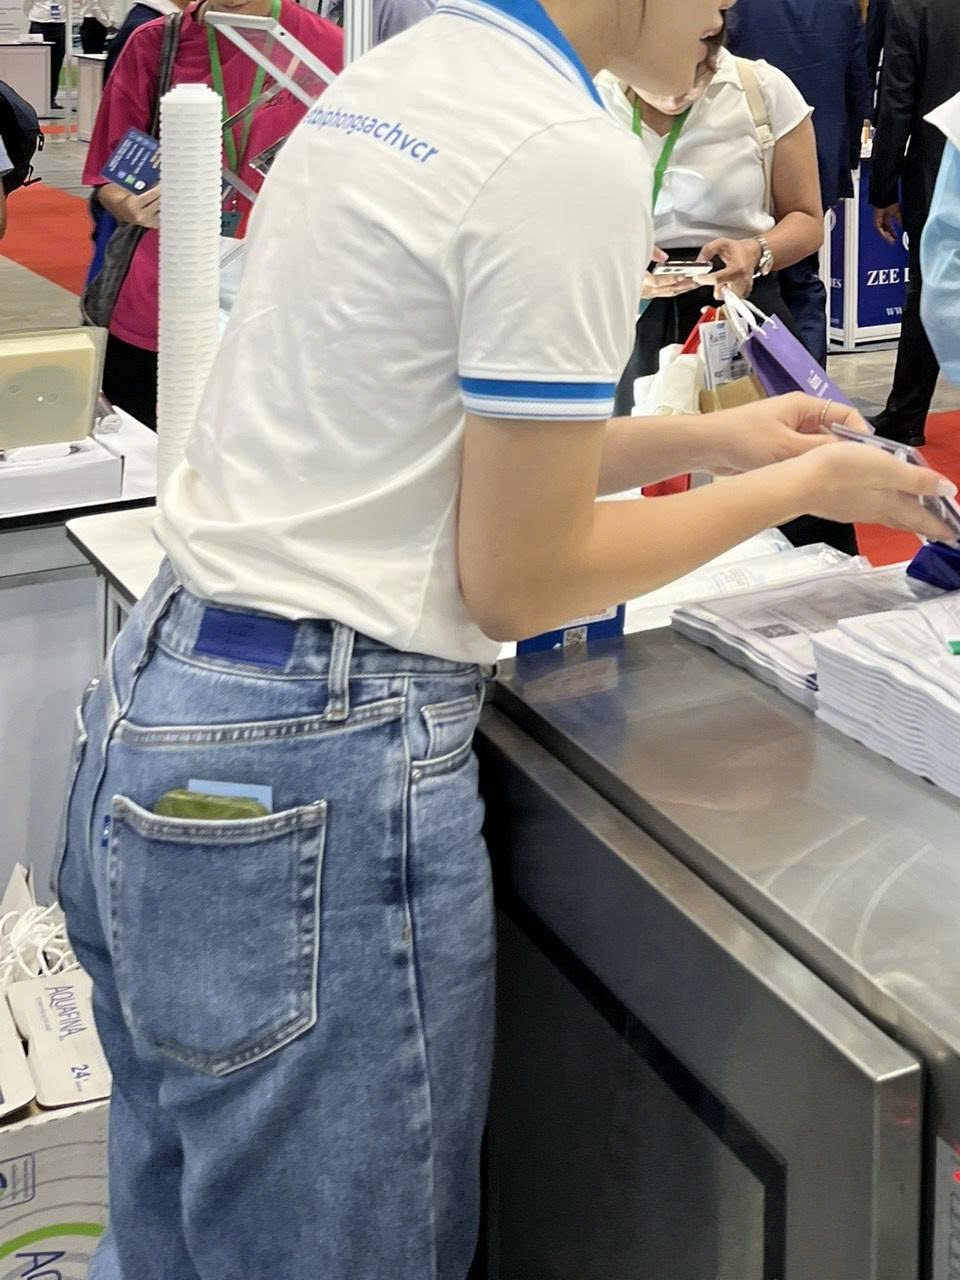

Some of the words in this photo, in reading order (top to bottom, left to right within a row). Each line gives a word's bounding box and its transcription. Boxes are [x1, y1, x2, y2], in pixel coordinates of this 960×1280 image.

[867, 268, 900, 286] ZEE
[45, 985, 88, 1038] AQUAFINA
[71, 1064, 91, 1079] 24
